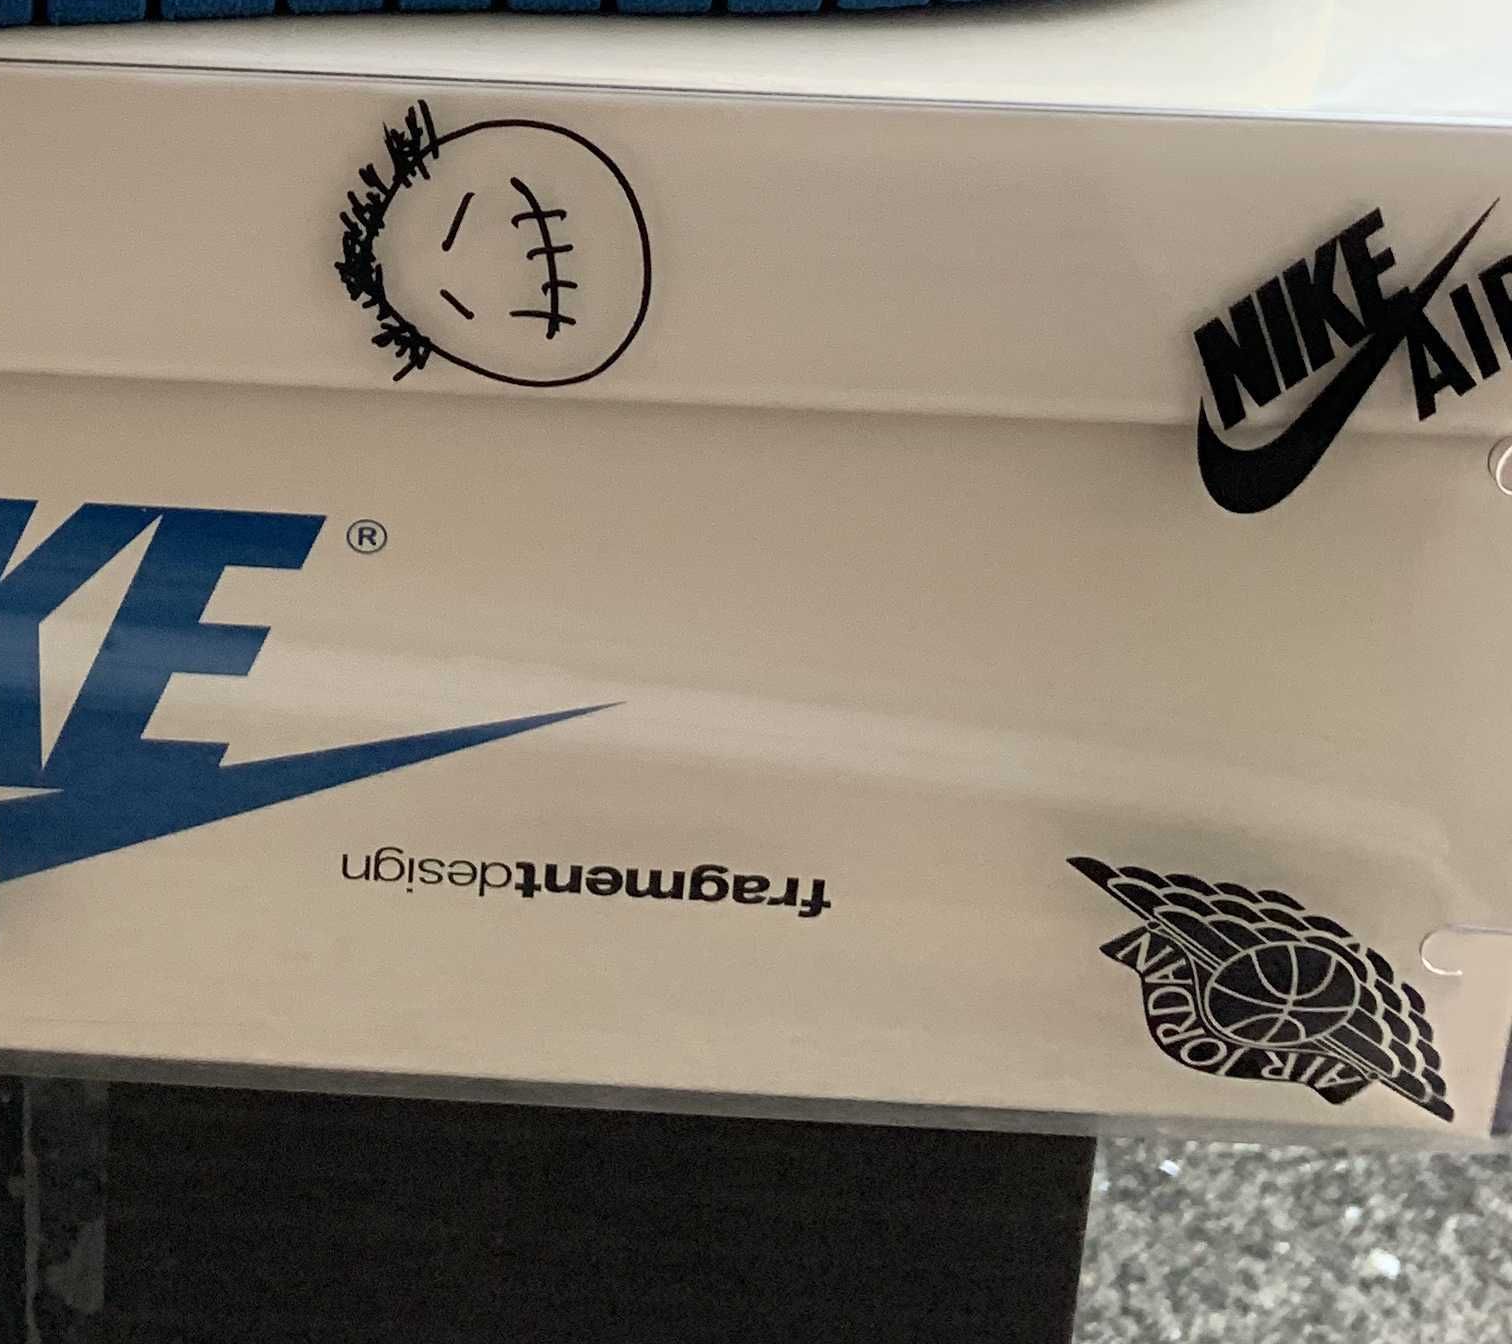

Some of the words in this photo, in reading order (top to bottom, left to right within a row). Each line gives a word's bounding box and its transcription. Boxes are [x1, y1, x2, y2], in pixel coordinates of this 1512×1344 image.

[1193, 207, 1412, 431] NIKE
[340, 845, 833, 919] fragmentdesign
[1114, 929, 1252, 1077] JORDAN
[1259, 1049, 1364, 1091] AIR
